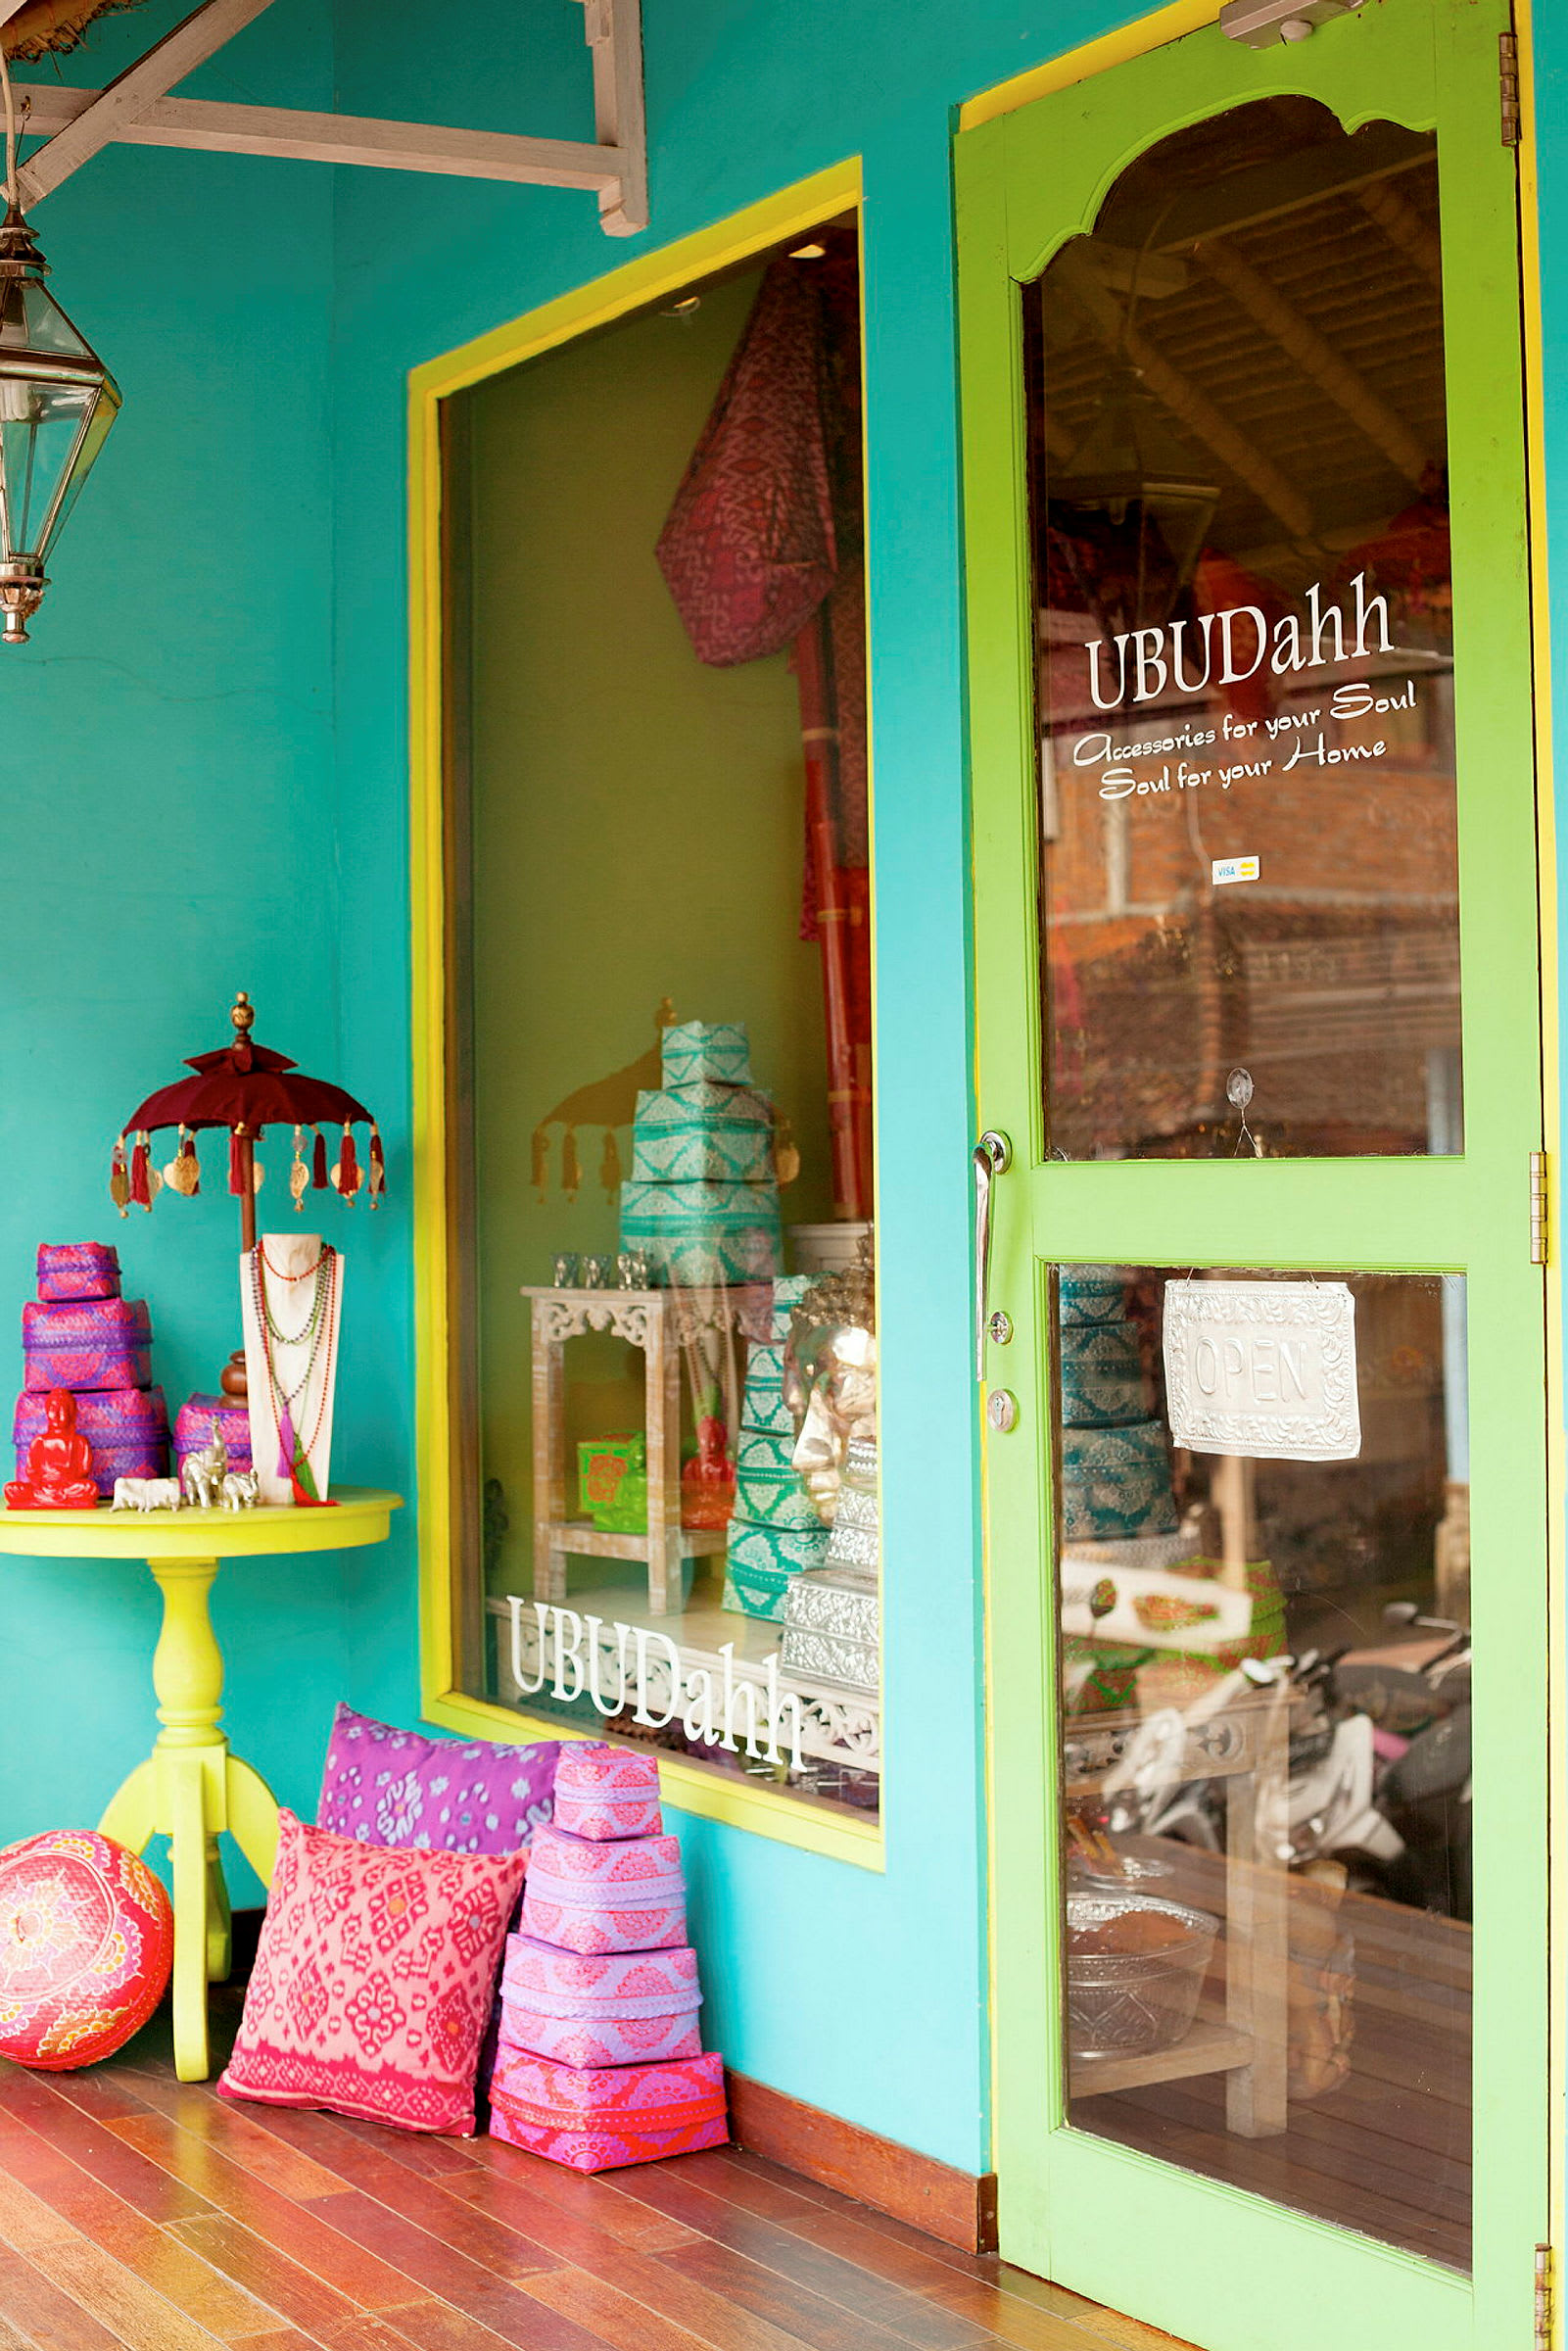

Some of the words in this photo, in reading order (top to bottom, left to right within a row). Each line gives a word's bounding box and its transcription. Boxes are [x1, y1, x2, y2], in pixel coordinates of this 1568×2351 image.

[1085, 572, 1395, 709] UBUDahh
[1072, 723, 1216, 767] Accessories
[1222, 714, 1258, 742] for
[1265, 708, 1321, 740] your
[1330, 680, 1416, 719] Soul
[1098, 766, 1171, 800] Soul
[1177, 764, 1212, 790] for
[1218, 758, 1272, 790] your
[1282, 732, 1388, 772] Home
[1218, 866, 1235, 877] VISA
[1195, 1337, 1308, 1404] OPEN
[506, 1595, 808, 1772] UBUDahh
